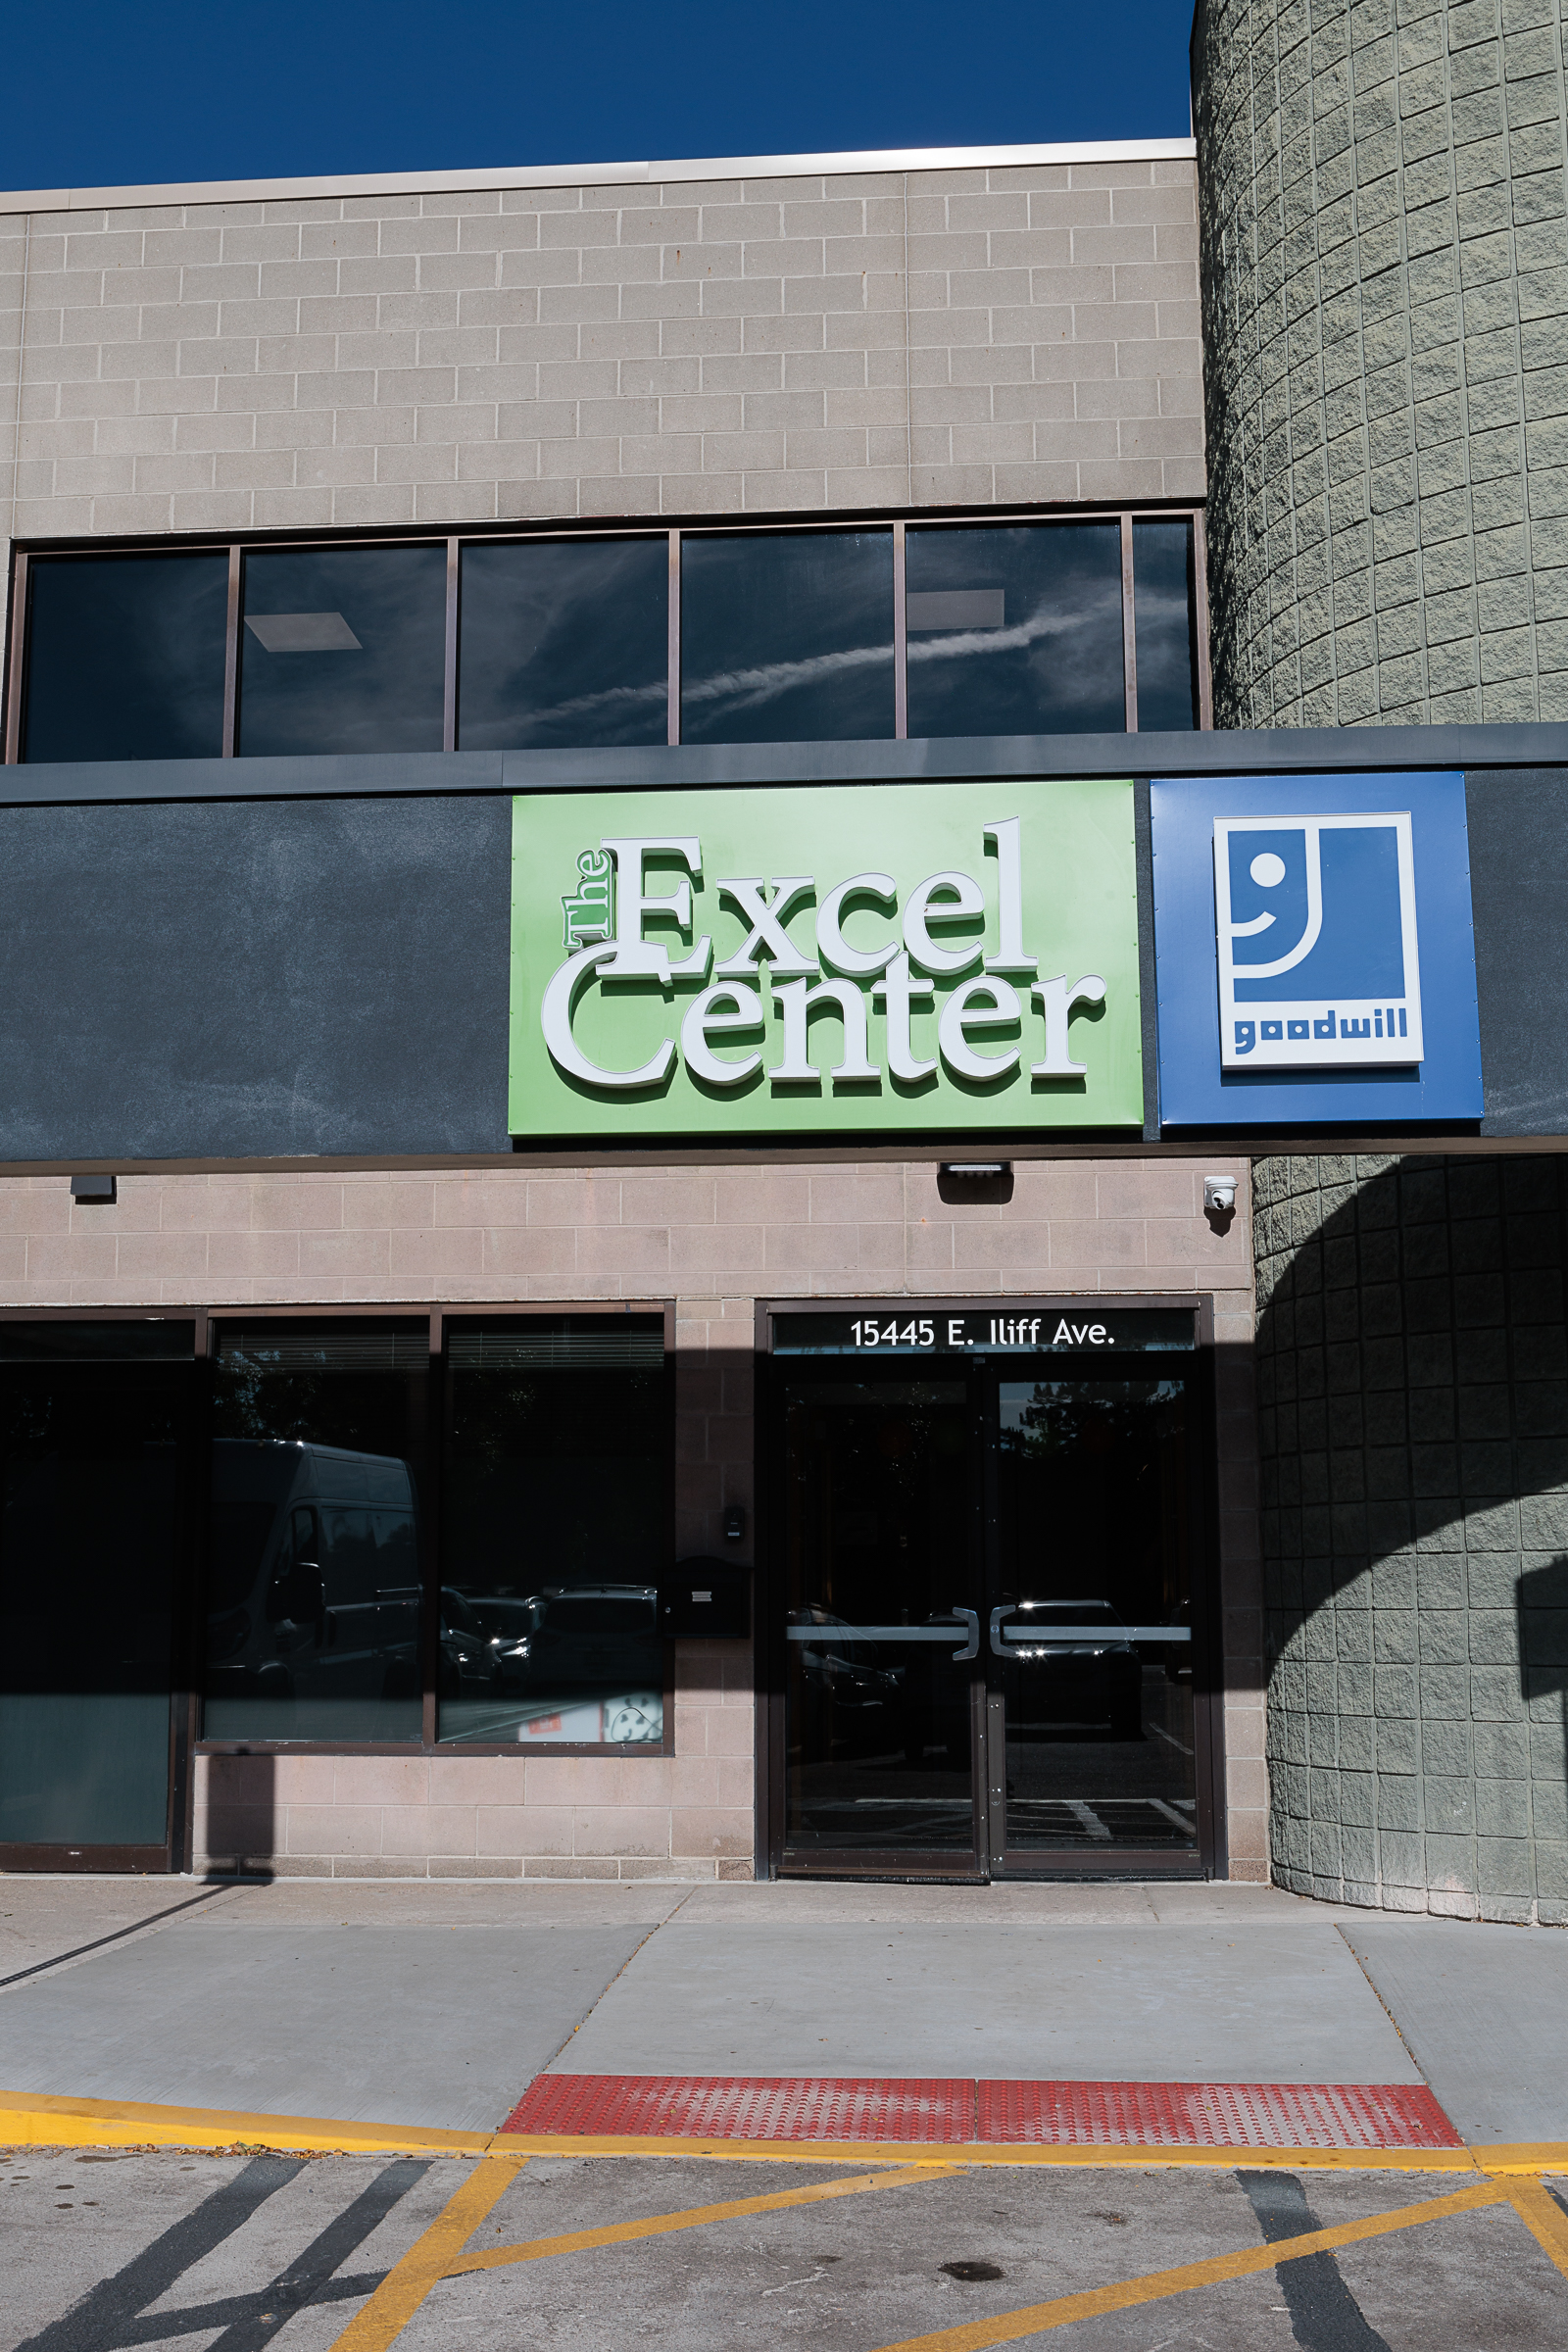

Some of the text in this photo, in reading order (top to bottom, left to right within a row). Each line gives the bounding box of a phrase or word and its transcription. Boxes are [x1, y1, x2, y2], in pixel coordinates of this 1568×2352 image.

[563, 849, 612, 949] The
[596, 816, 1039, 981] Excel
[541, 940, 1107, 1086] Center
[1234, 1007, 1408, 1055] goodwill
[850, 1318, 1115, 1347] 15445 E. Iliff Ave.
